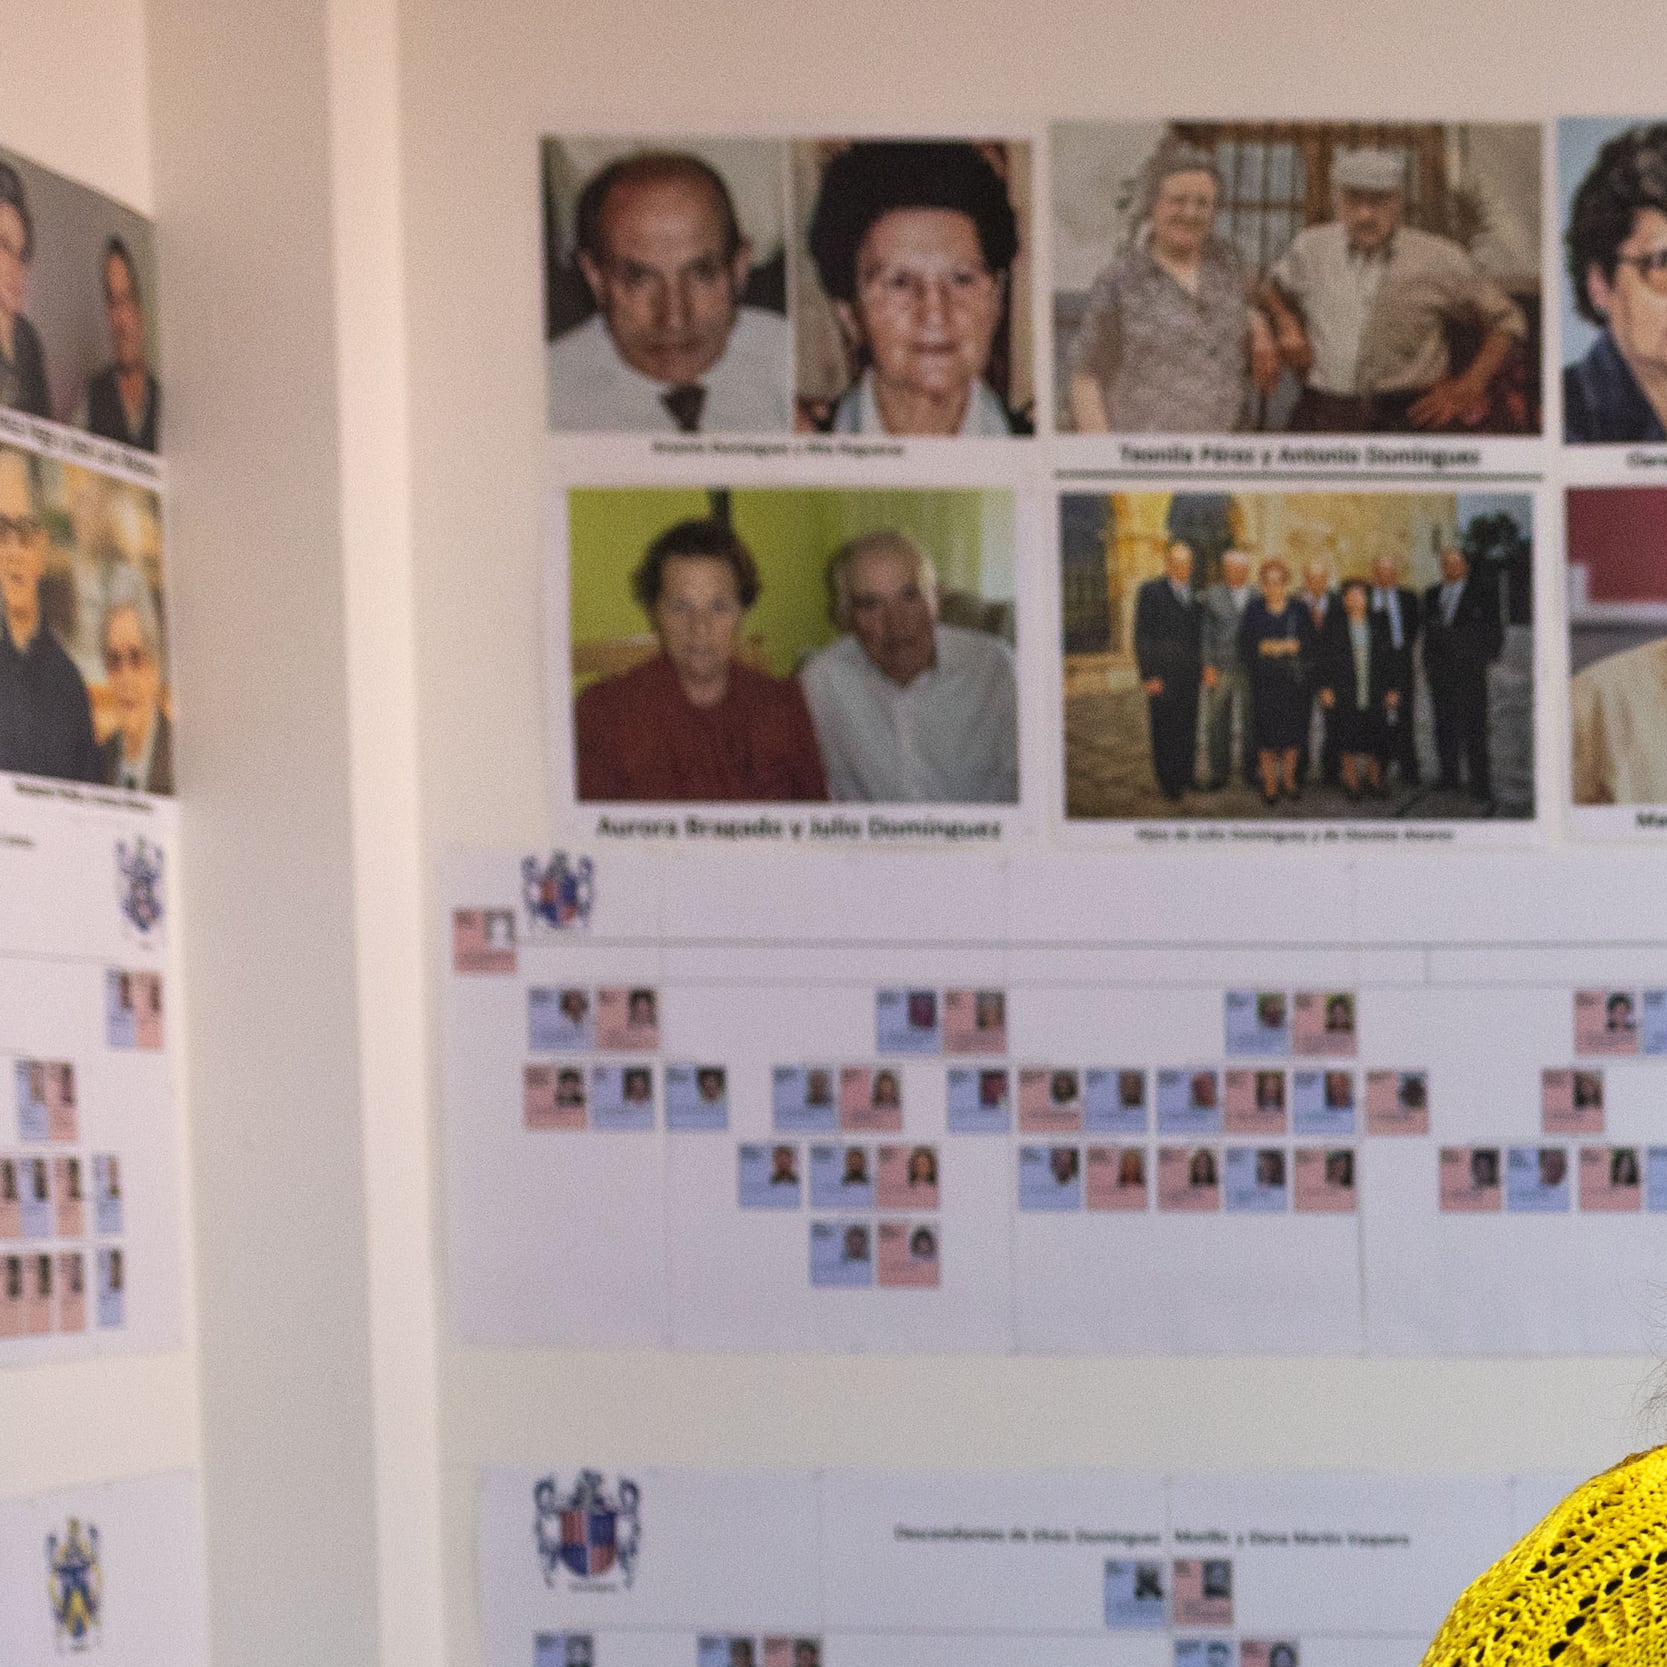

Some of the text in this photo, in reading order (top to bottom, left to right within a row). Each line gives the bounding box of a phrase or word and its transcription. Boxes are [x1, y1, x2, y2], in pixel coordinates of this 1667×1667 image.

[1260, 448, 1272, 468] y
[1276, 443, 1358, 463] Antonio
[597, 816, 677, 839] Aurora
[683, 814, 783, 842] Bragado
[788, 820, 801, 841] y
[809, 815, 864, 839] Julio
